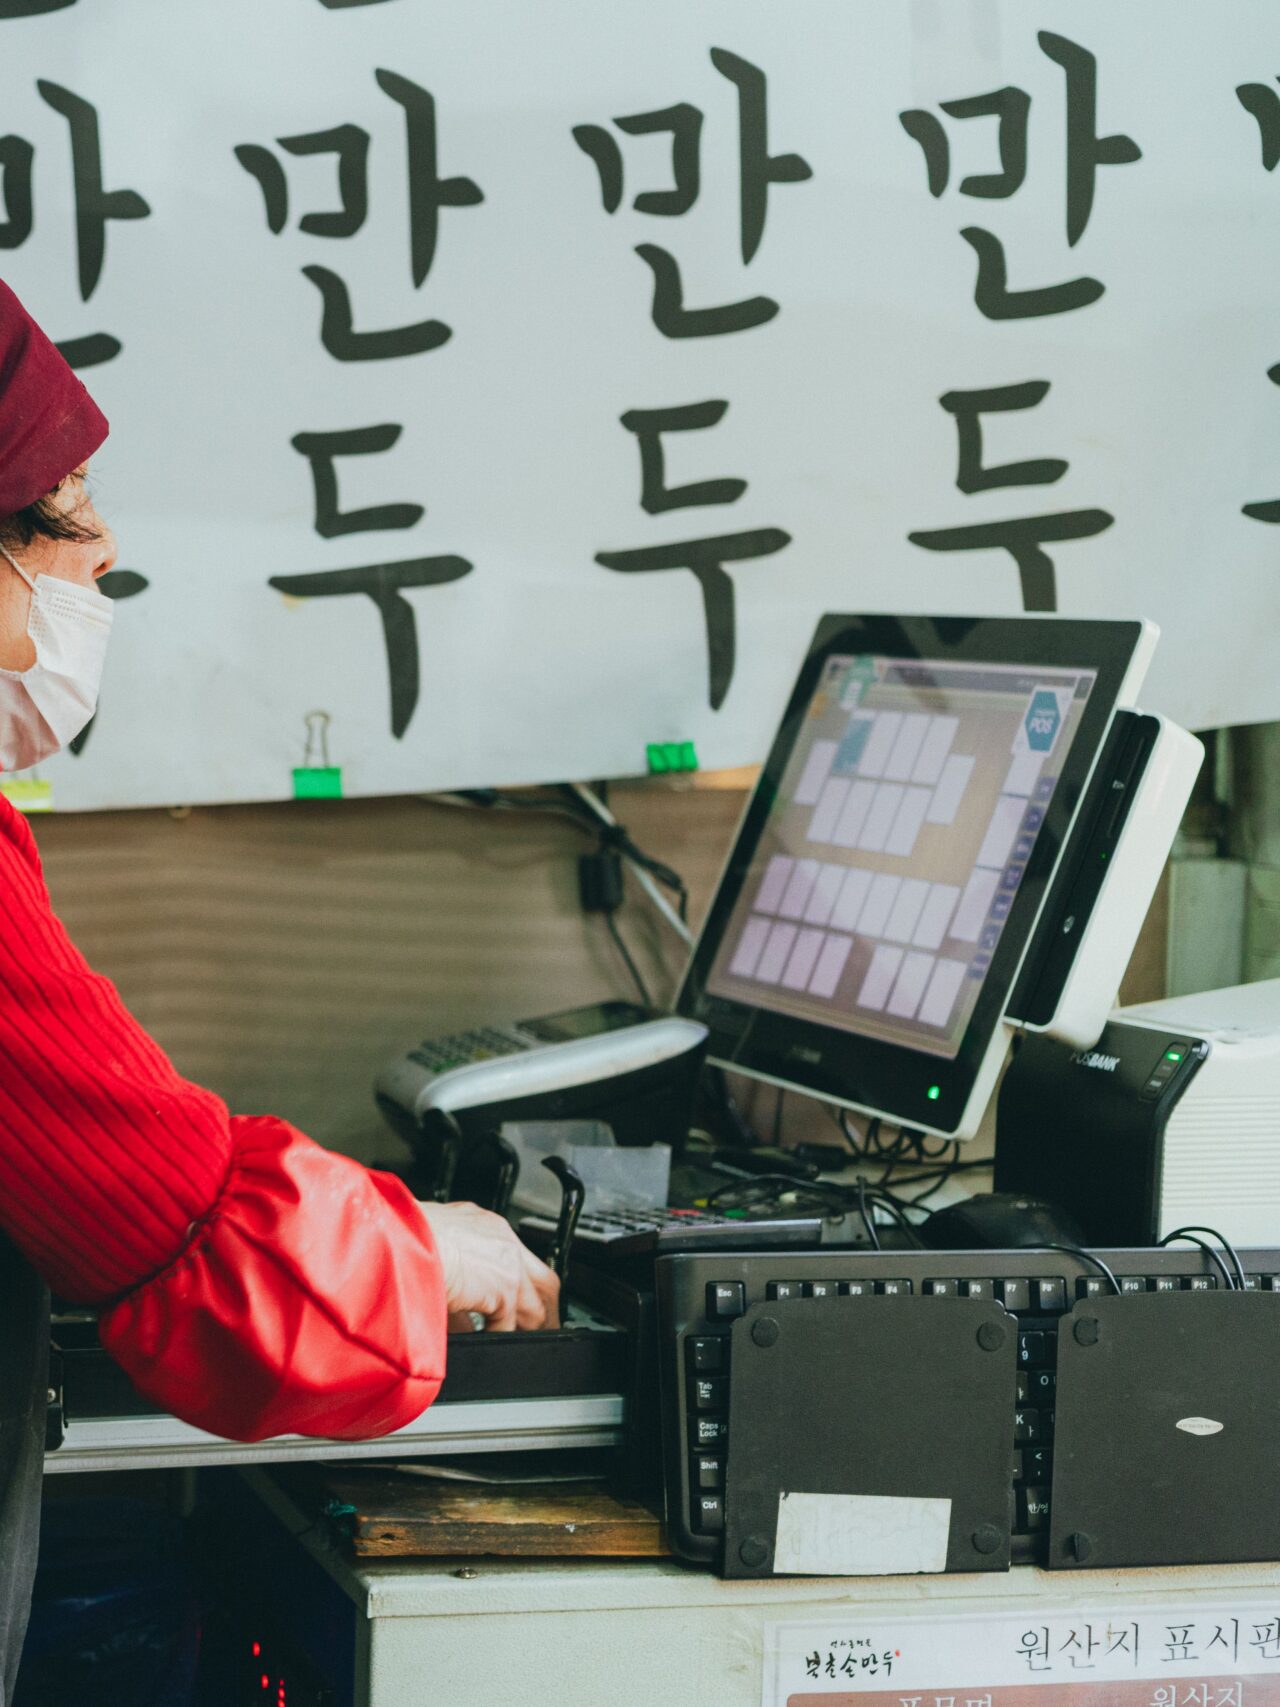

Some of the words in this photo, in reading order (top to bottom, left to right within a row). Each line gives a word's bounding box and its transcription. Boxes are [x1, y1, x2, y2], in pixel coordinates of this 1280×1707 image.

[899, 31, 1142, 611] 만두
[572, 47, 813, 711] 만두
[234, 68, 484, 739] 만두
[935, 1285, 946, 1293] F5
[971, 1284, 981, 1293] F6
[1007, 1284, 1017, 1292] F7
[1089, 1282, 1100, 1291] F9
[1124, 1282, 1138, 1290] F10
[1159, 1282, 1173, 1290] F11
[1193, 1281, 1208, 1289] F12
[718, 1289, 732, 1297] Esc
[780, 1287, 789, 1296] F1
[815, 1287, 826, 1296] F2
[851, 1286, 862, 1295] F3
[887, 1286, 898, 1295] F4
[1021, 1350, 1029, 1361] 9
[699, 1382, 712, 1390] Tab
[1015, 1414, 1024, 1424] K
[699, 1422, 718, 1431] Caps
[700, 1429, 717, 1437] Lock
[700, 1461, 718, 1470] Shift
[702, 1501, 717, 1510] Ctrl
[1015, 1622, 1140, 1672] 원산지
